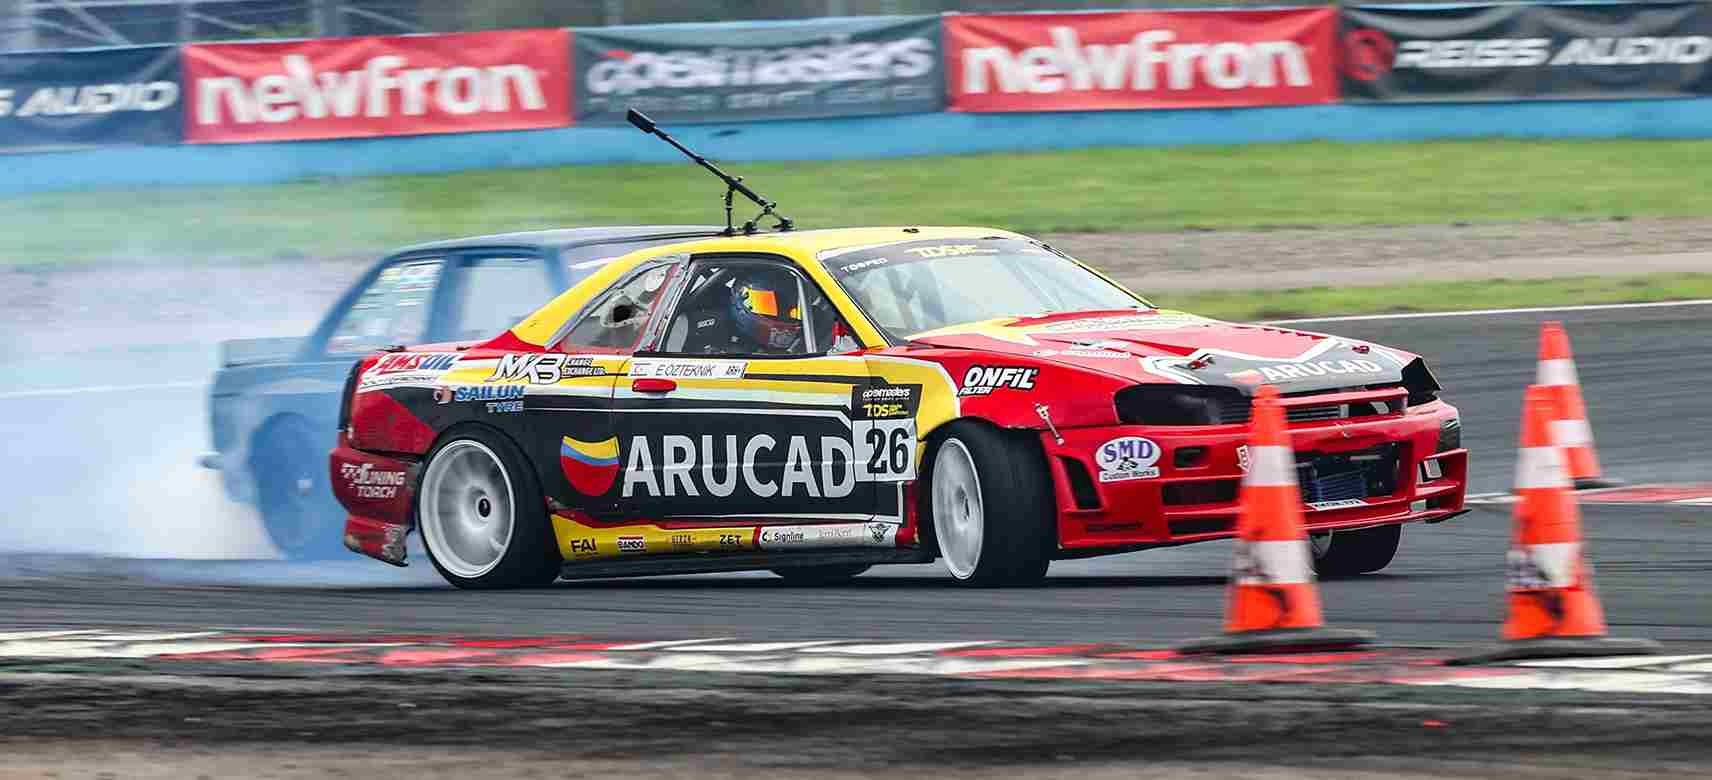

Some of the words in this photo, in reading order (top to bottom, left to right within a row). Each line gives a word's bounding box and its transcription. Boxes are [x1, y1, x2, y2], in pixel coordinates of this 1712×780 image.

[961, 26, 1311, 94] newfron
[1549, 36, 1712, 65] AUDIO
[16, 80, 179, 117] AUDIO
[195, 54, 547, 125] newfron
[1260, 359, 1383, 382] ARUCAD
[455, 385, 526, 401] SAILUN
[621, 433, 856, 498] ARUCAD
[865, 427, 909, 474] 26
[1103, 440, 1153, 463] SMD
[719, 534, 743, 546] ZET
